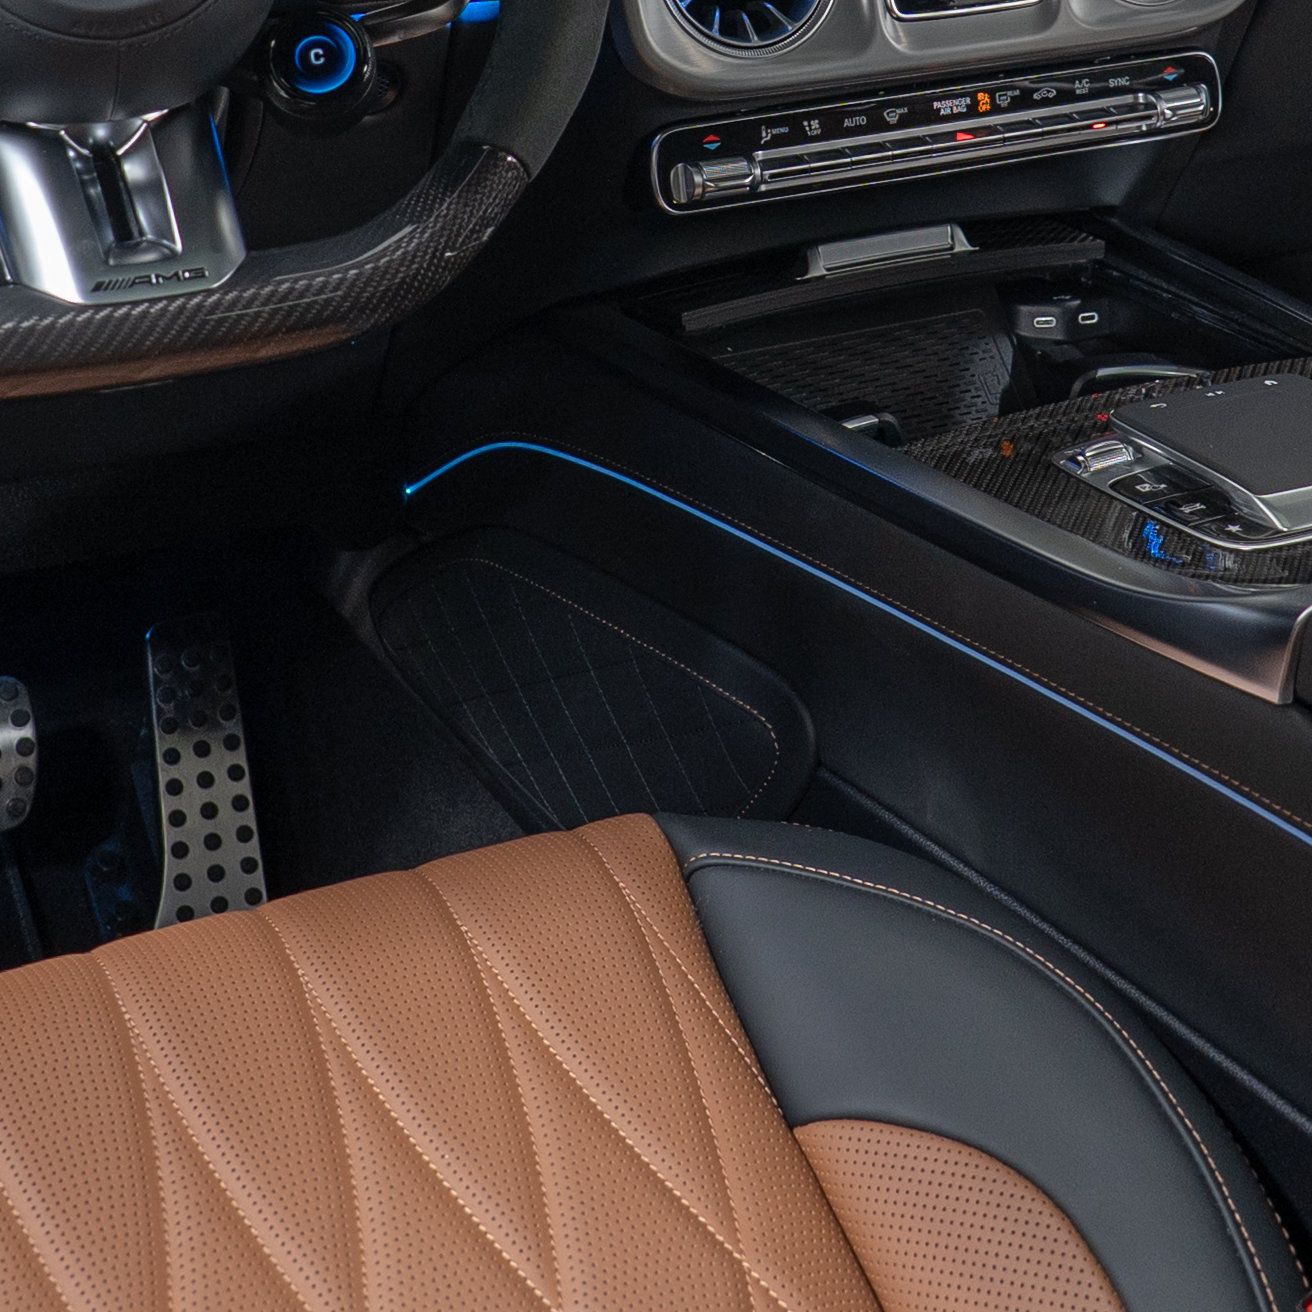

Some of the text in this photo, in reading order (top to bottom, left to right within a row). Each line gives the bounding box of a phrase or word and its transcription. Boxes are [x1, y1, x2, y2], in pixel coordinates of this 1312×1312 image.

[310, 48, 325, 65] C
[1074, 78, 1090, 89] A/C
[1108, 76, 1130, 87] SYNC
[1007, 89, 1021, 97] REAR
[933, 96, 971, 109] PASSENGER
[896, 106, 909, 114] MAX
[939, 104, 967, 115] AIR BAG
[843, 115, 867, 128] AUTO
[771, 126, 789, 135] MENU
[810, 128, 822, 136] OFF
[128, 266, 209, 288] AMG
